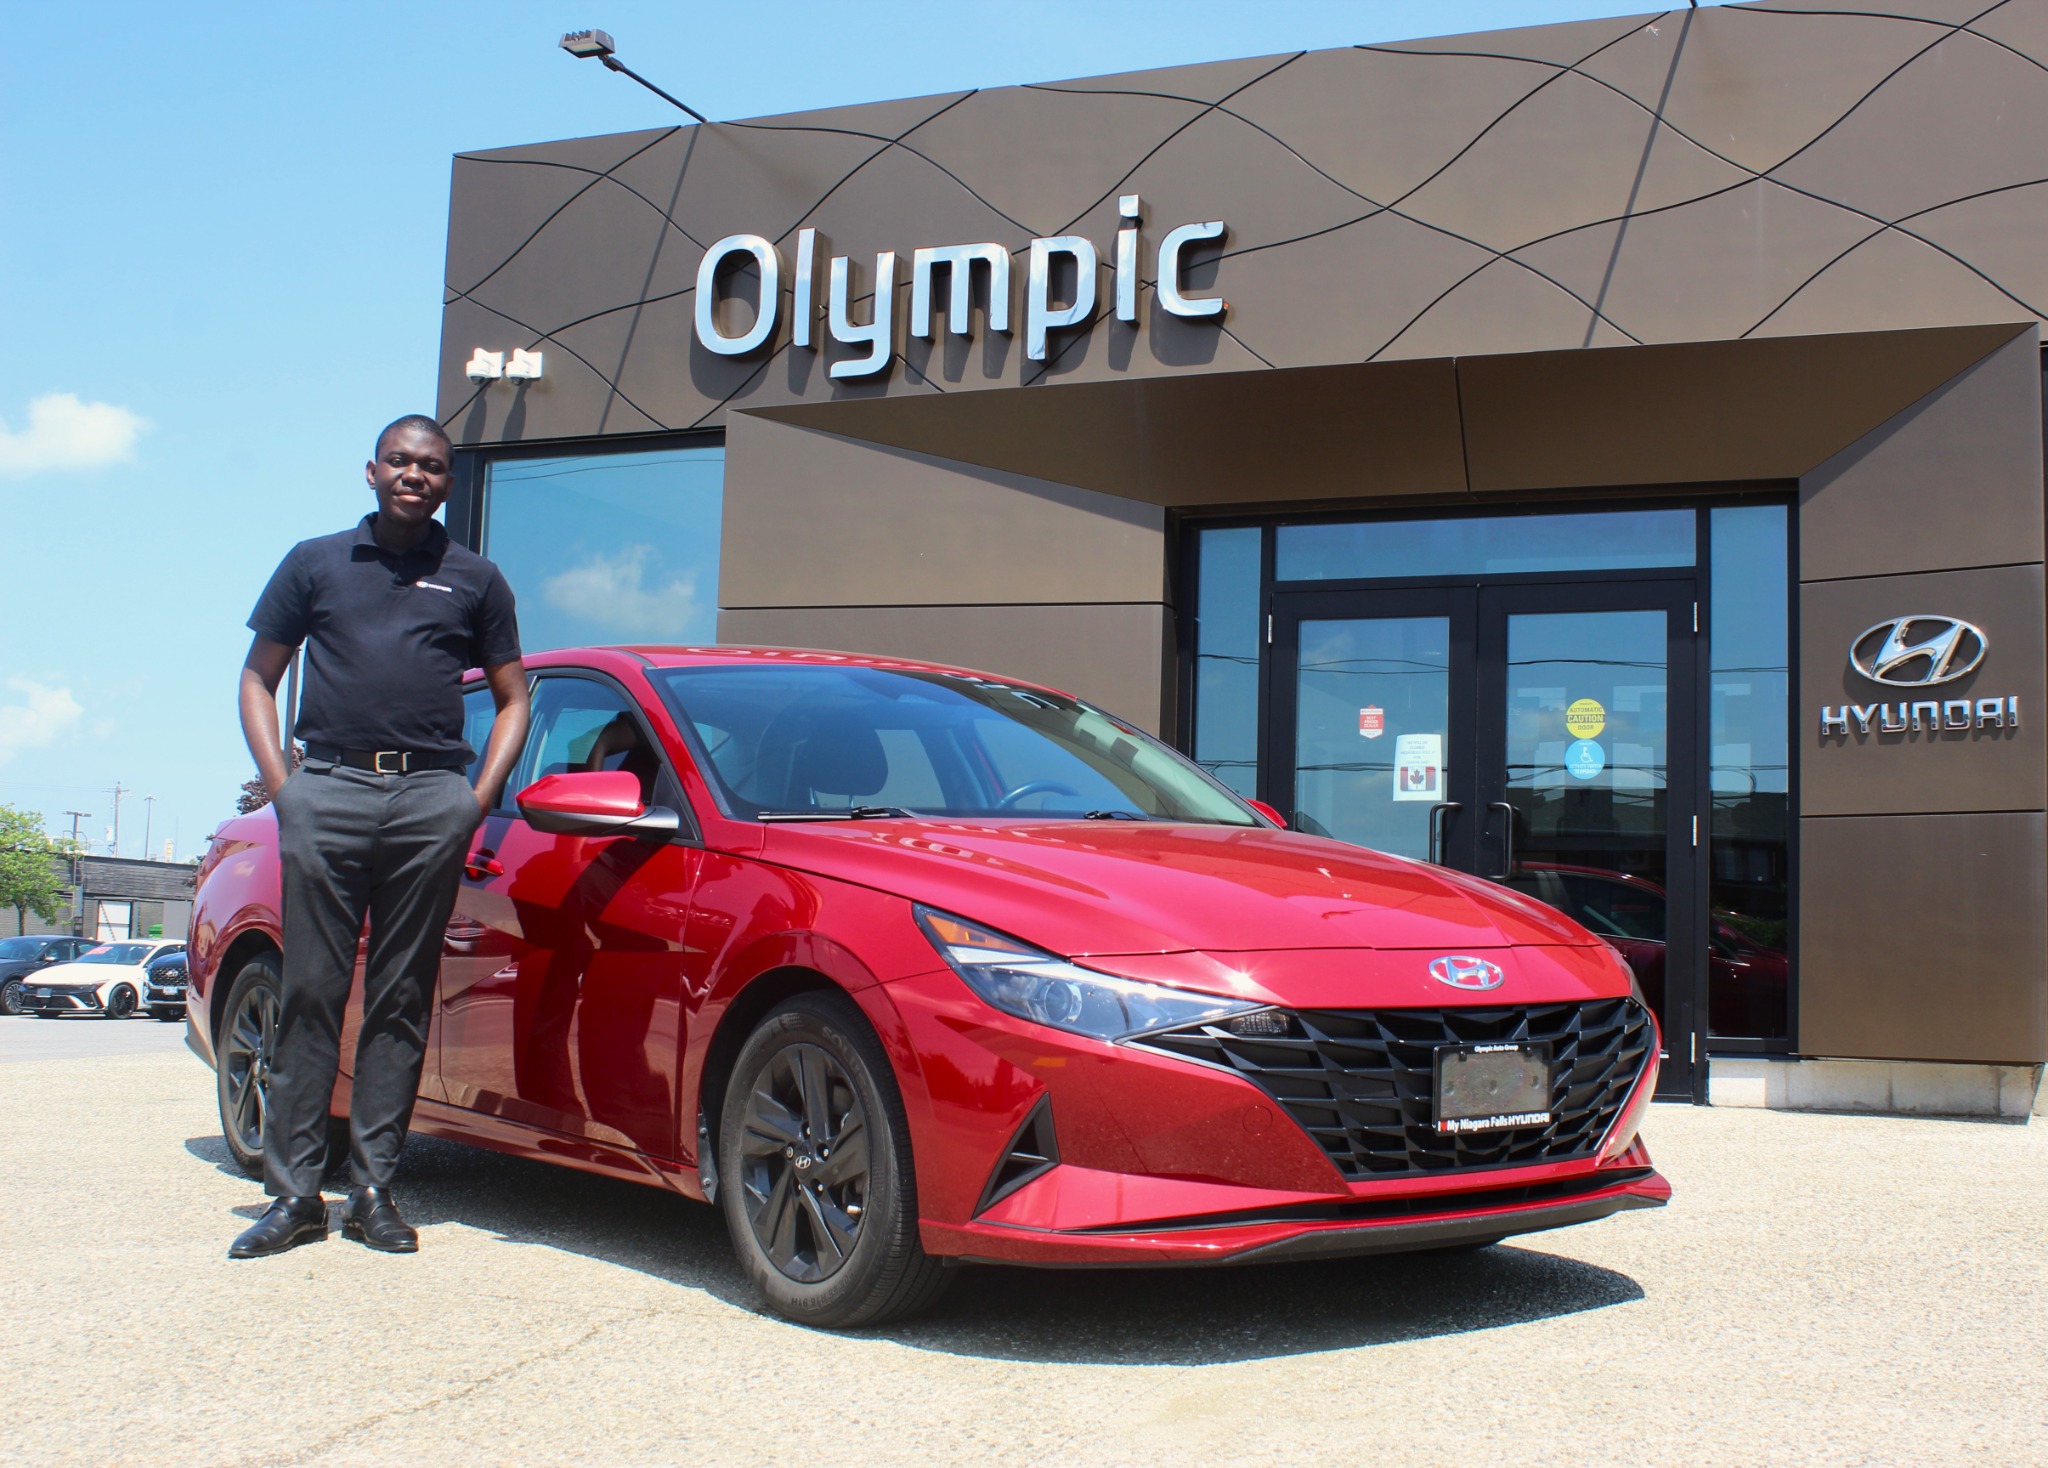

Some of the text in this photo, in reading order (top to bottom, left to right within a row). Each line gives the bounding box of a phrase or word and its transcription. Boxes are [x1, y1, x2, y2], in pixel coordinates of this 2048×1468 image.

[694, 194, 1226, 378] Olympic
[1567, 714, 1604, 723] CAUTION
[1820, 695, 2019, 736] HYUNDAI
[1474, 1044, 1493, 1053] Olympic
[1504, 1043, 1519, 1052] Group
[1446, 1119, 1460, 1133] My
[1460, 1118, 1490, 1132] Niagara
[1490, 1116, 1508, 1128] Falls
[1508, 1112, 1550, 1125] HYUNDAI
